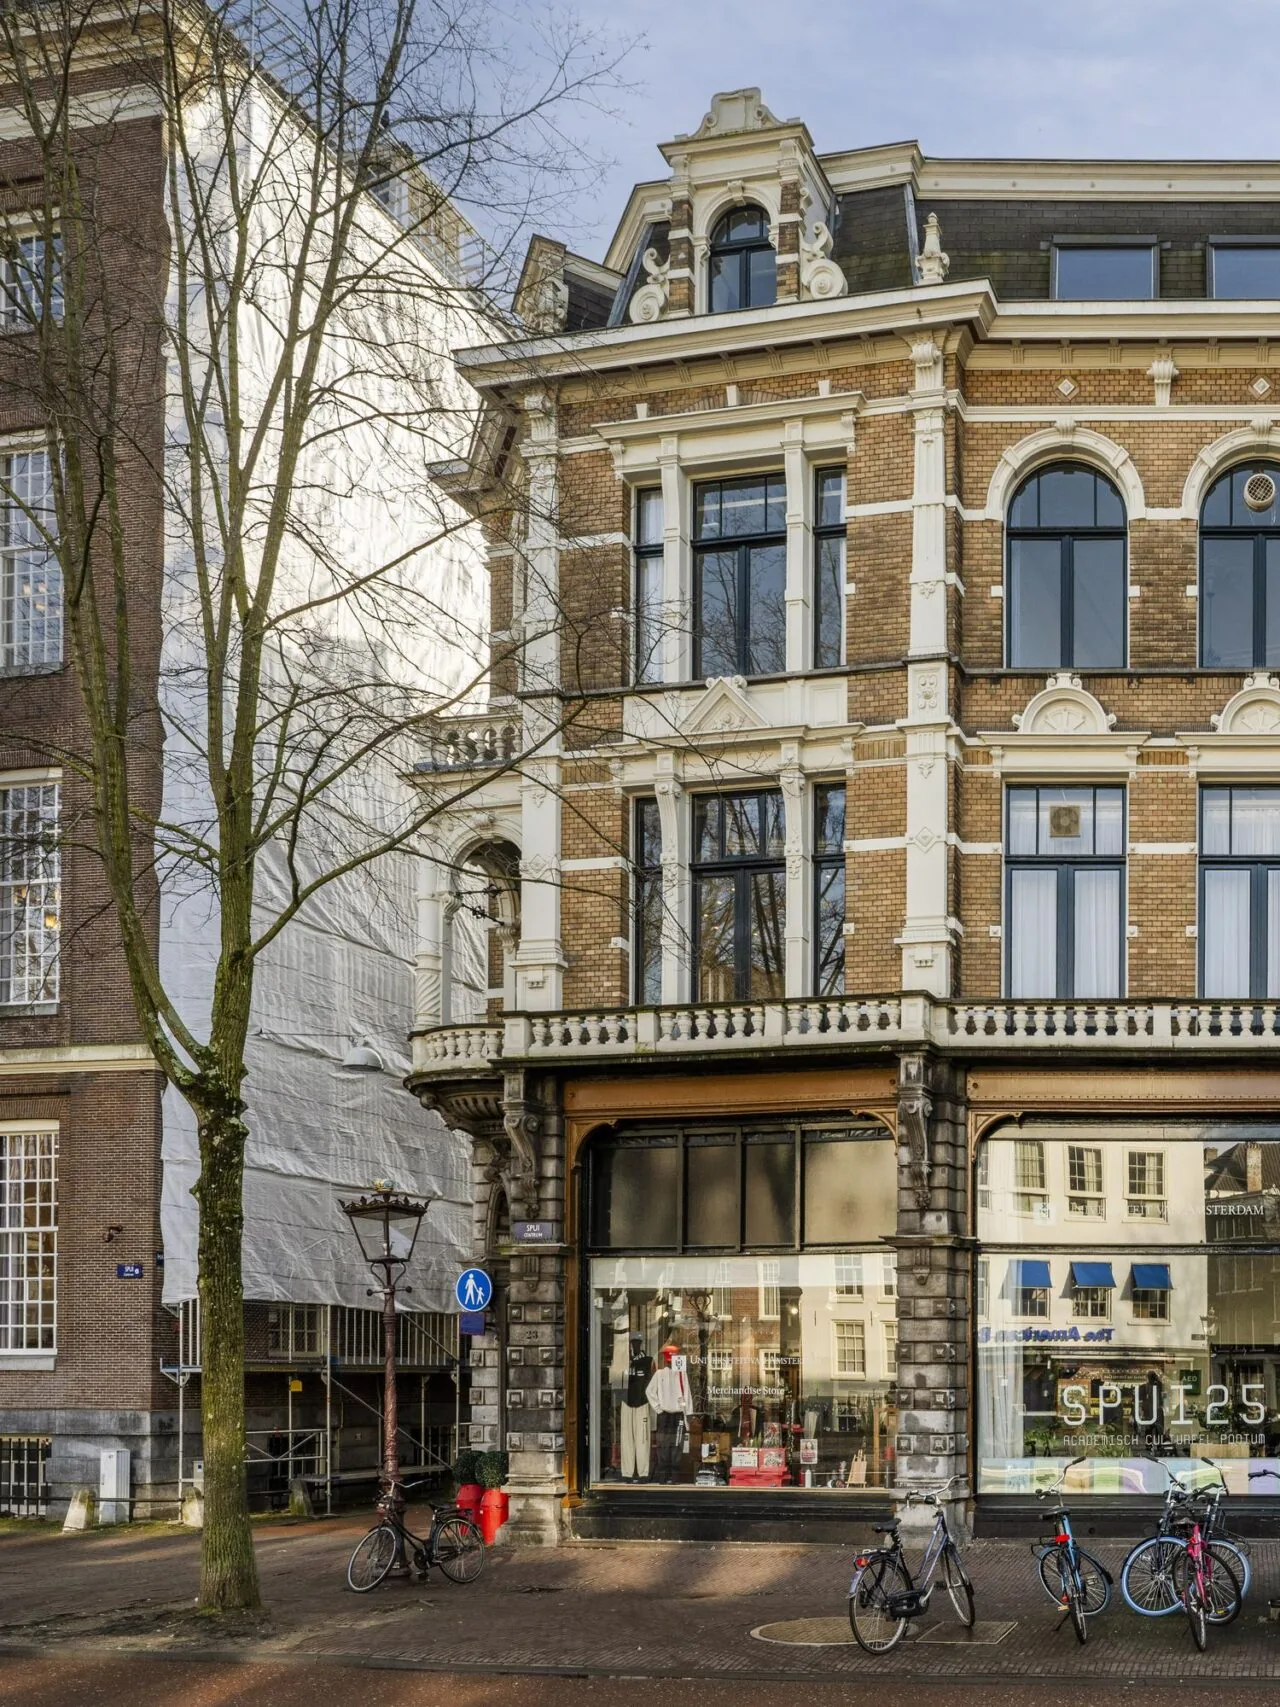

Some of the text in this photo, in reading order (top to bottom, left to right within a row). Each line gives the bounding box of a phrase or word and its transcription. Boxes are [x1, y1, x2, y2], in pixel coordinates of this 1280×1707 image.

[526, 1224, 540, 1232] SPUI
[1182, 1375, 1198, 1383] AED
[707, 1385, 785, 1395] Merchandise Store
[1063, 1384, 1265, 1426] SPUI25
[1063, 1433, 1139, 1446] ACADEMISCH
[1220, 1433, 1266, 1446] PODIUM
